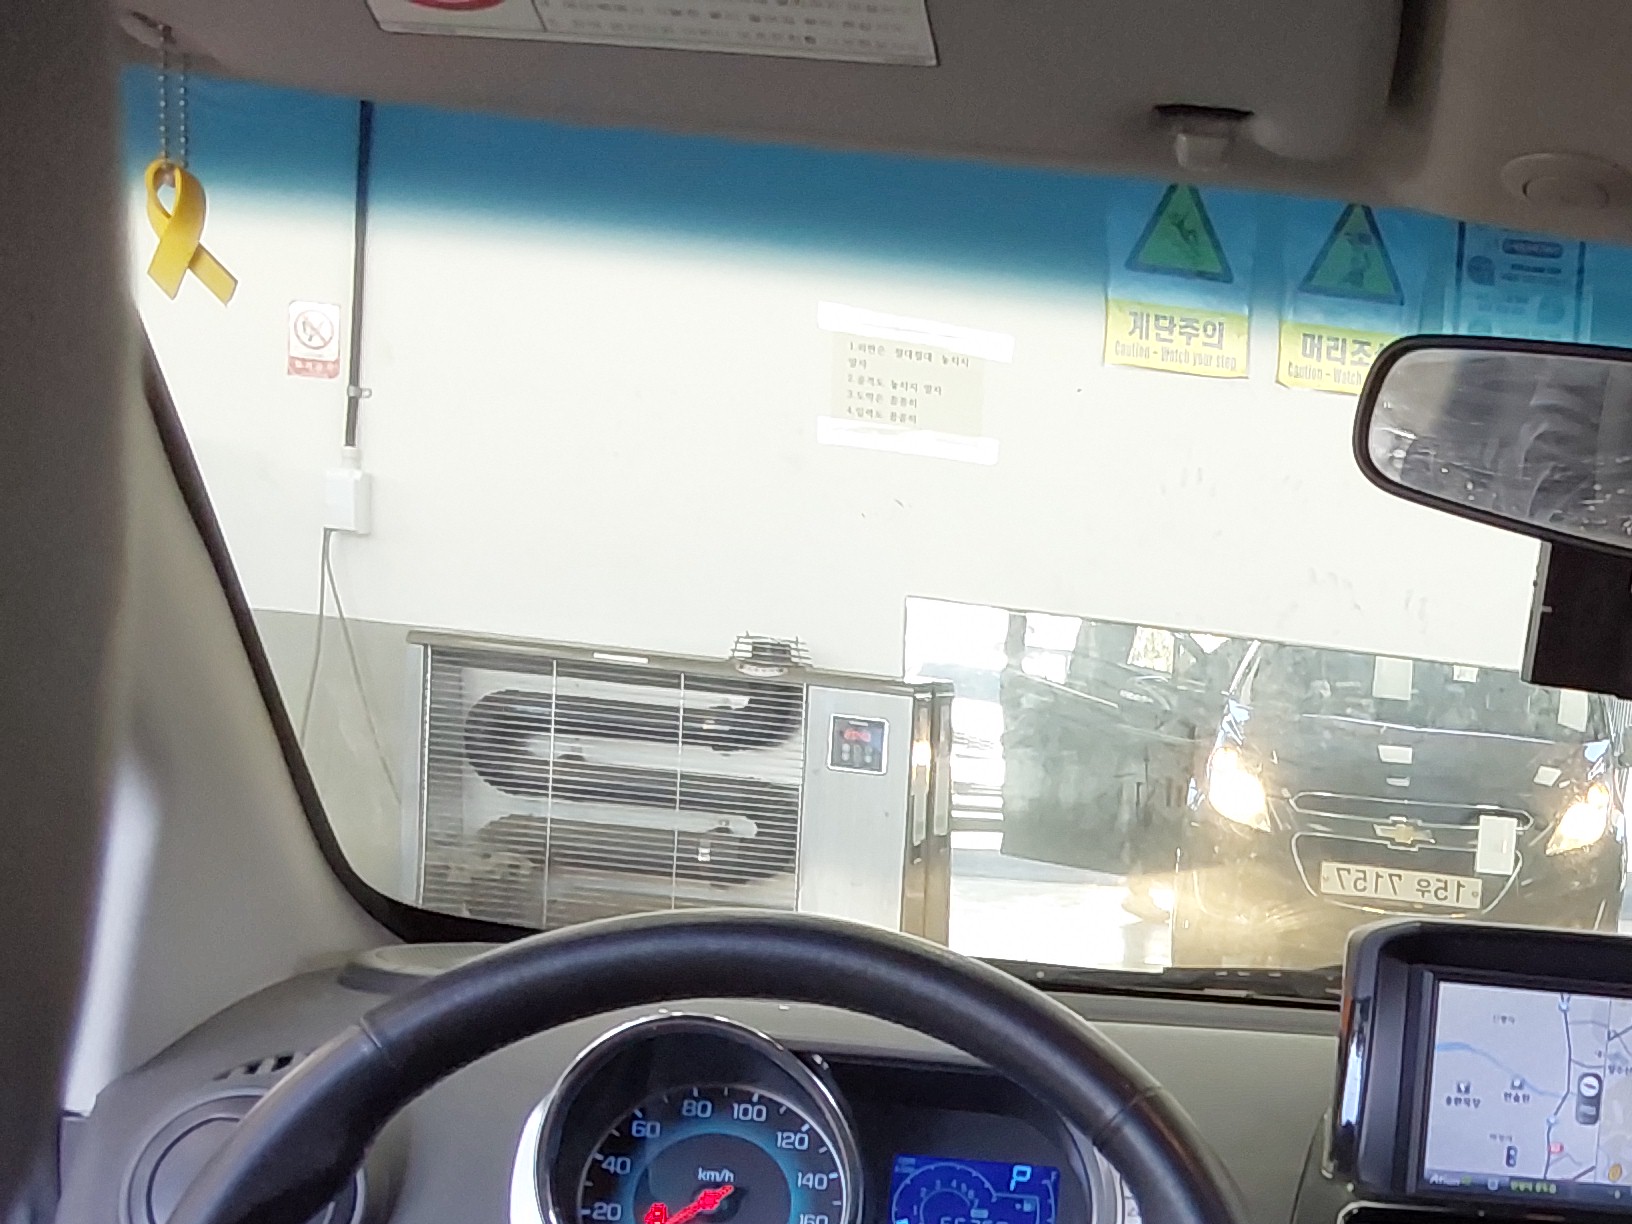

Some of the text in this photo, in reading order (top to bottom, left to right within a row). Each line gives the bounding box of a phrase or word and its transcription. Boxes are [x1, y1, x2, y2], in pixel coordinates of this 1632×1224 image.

[1128, 310, 1225, 351] 계단주의
[1115, 340, 1151, 359] Caution
[1161, 346, 1191, 366] Watch
[1193, 350, 1213, 367] your
[1216, 351, 1237, 371] step
[1301, 332, 1384, 368] 머리조
[1288, 361, 1323, 382] Caution
[1333, 368, 1362, 386] Watch
[682, 1100, 712, 1118] 80
[732, 1103, 767, 1122] 100
[631, 1121, 661, 1138] 60
[776, 1131, 809, 1150] 120
[602, 1156, 631, 1175] 40
[698, 1167, 735, 1183] km/h
[797, 1172, 828, 1190] 140
[1009, 1165, 1032, 1191] P
[592, 1203, 622, 1221] 20
